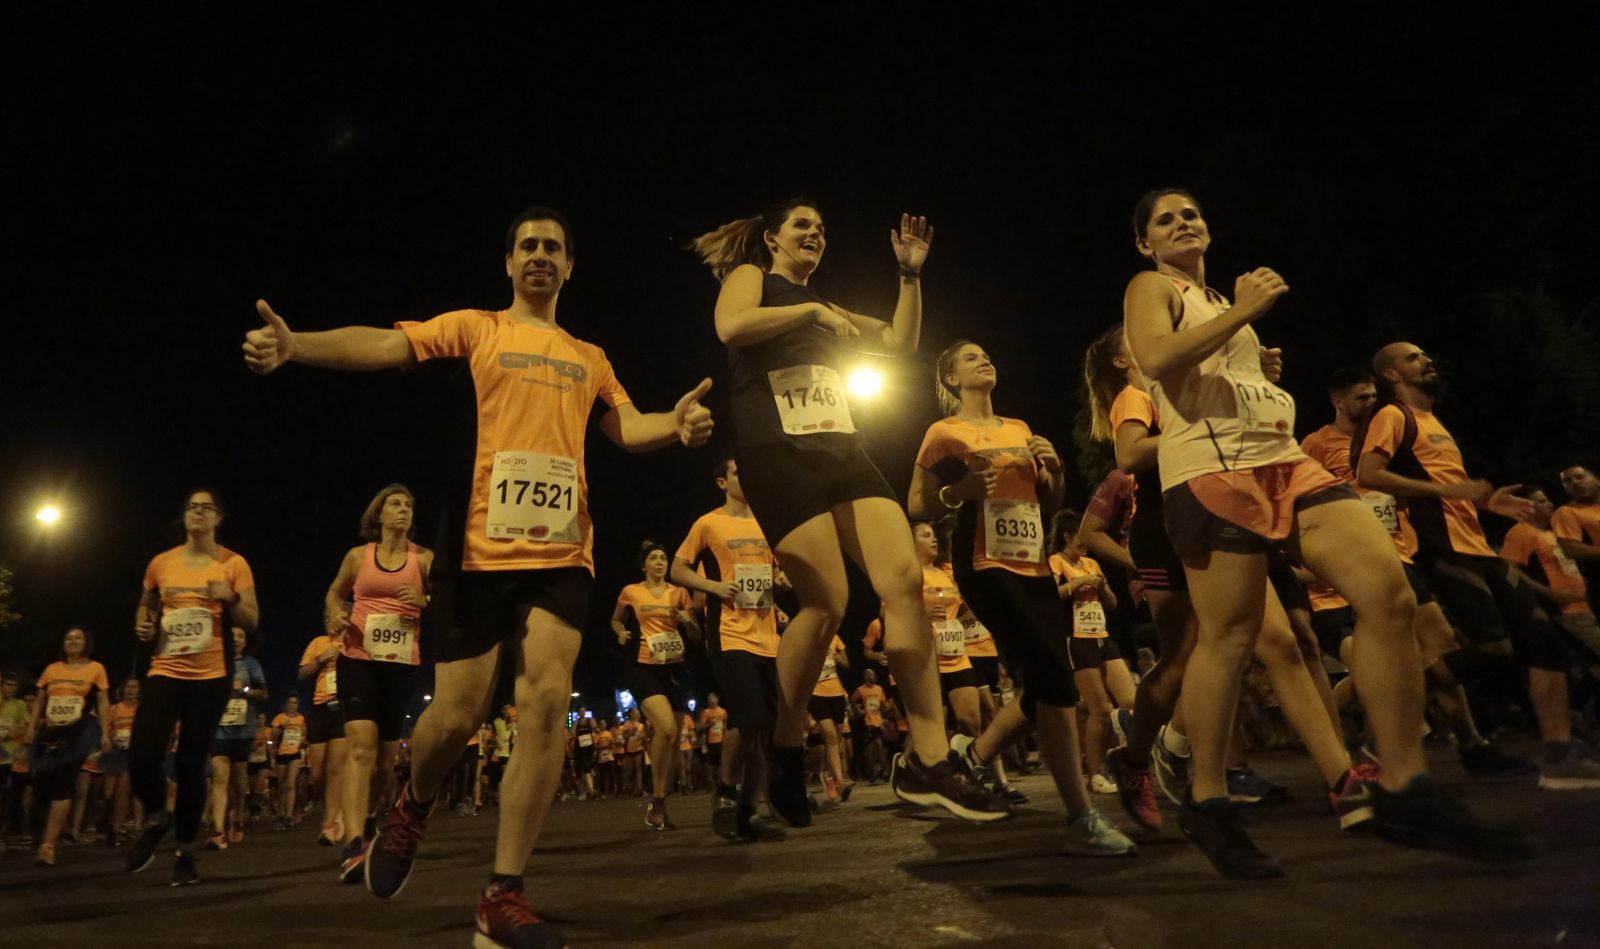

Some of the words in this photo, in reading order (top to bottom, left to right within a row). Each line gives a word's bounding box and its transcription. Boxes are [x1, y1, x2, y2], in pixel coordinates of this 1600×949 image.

[496, 479, 572, 511] 17521
[995, 518, 1037, 539] 6333
[1080, 611, 1102, 621] 5474
[372, 629, 407, 645] 9991
[652, 641, 683, 652] 13055
